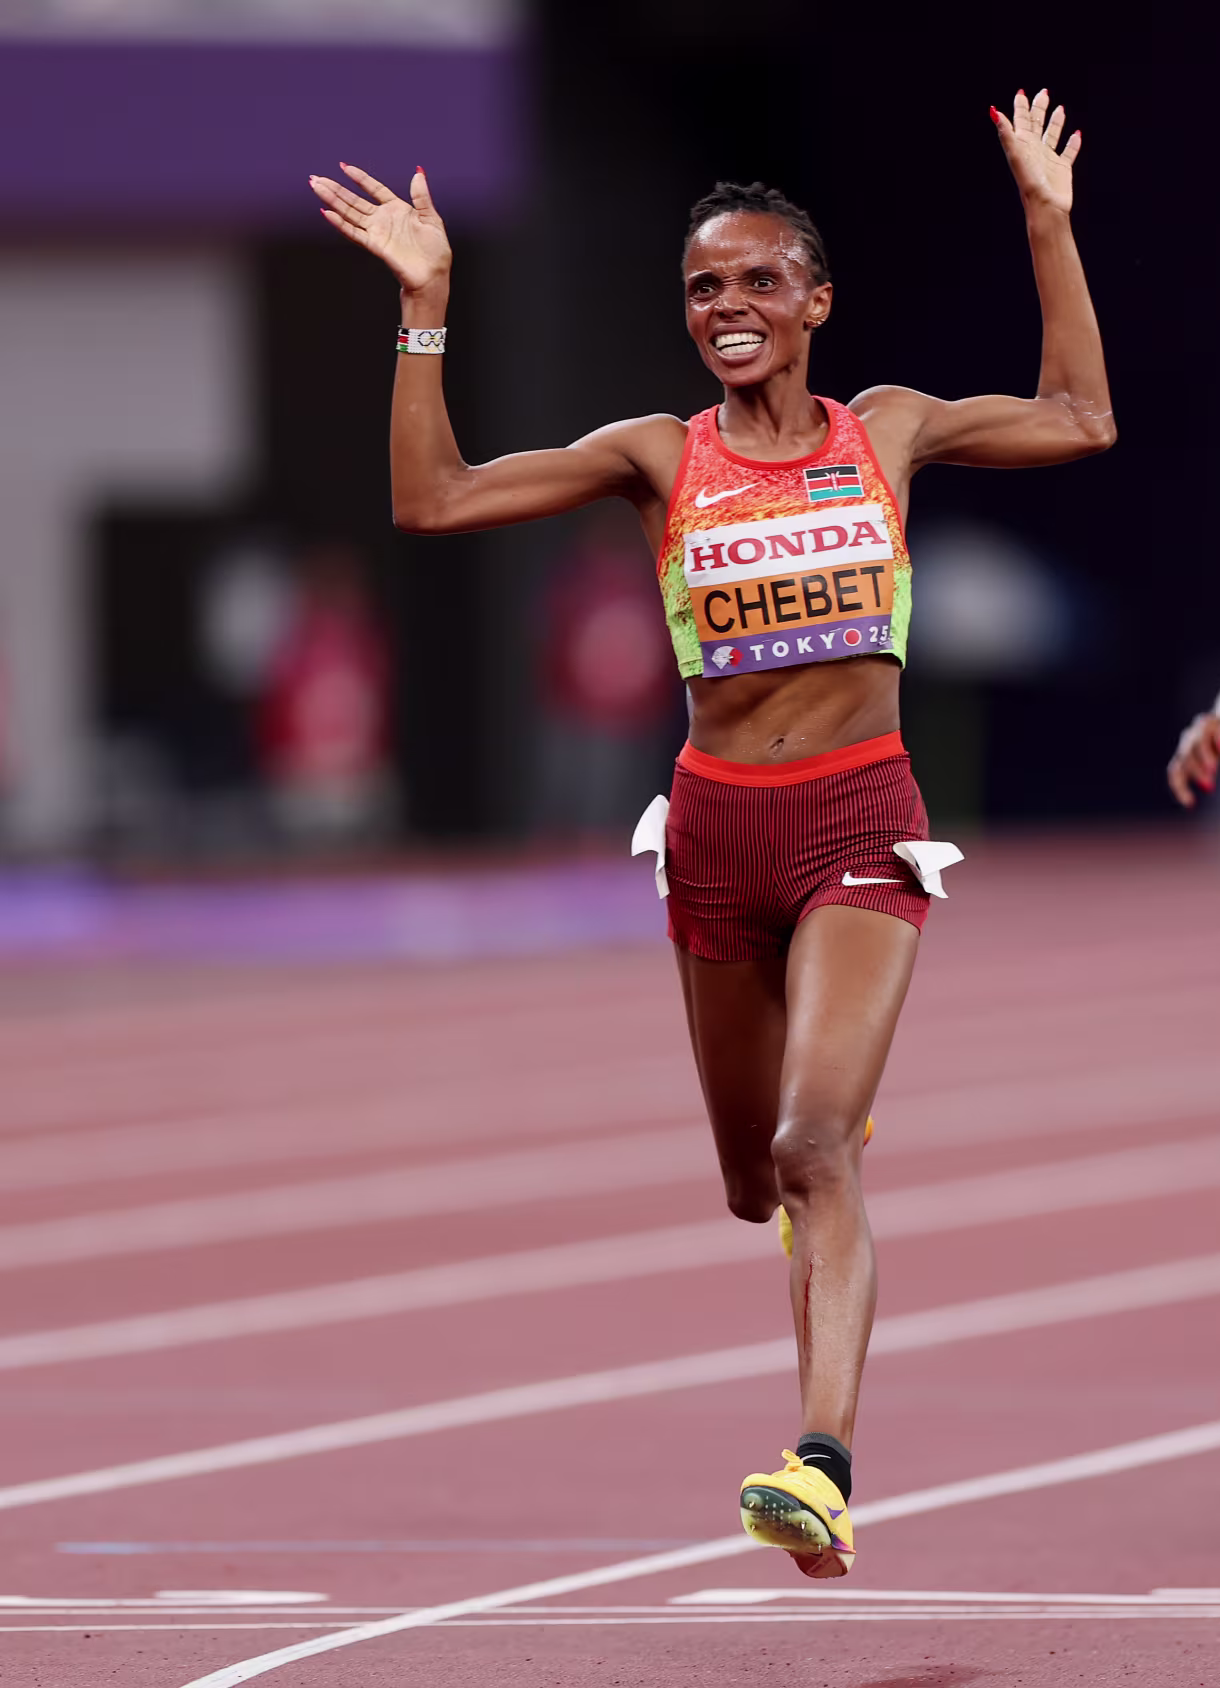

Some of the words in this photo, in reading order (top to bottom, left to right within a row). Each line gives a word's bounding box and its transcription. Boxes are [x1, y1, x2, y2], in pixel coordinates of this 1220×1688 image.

[690, 520, 887, 573] HONDA
[703, 565, 885, 634] CHEBET
[749, 627, 863, 663] TOKYO
